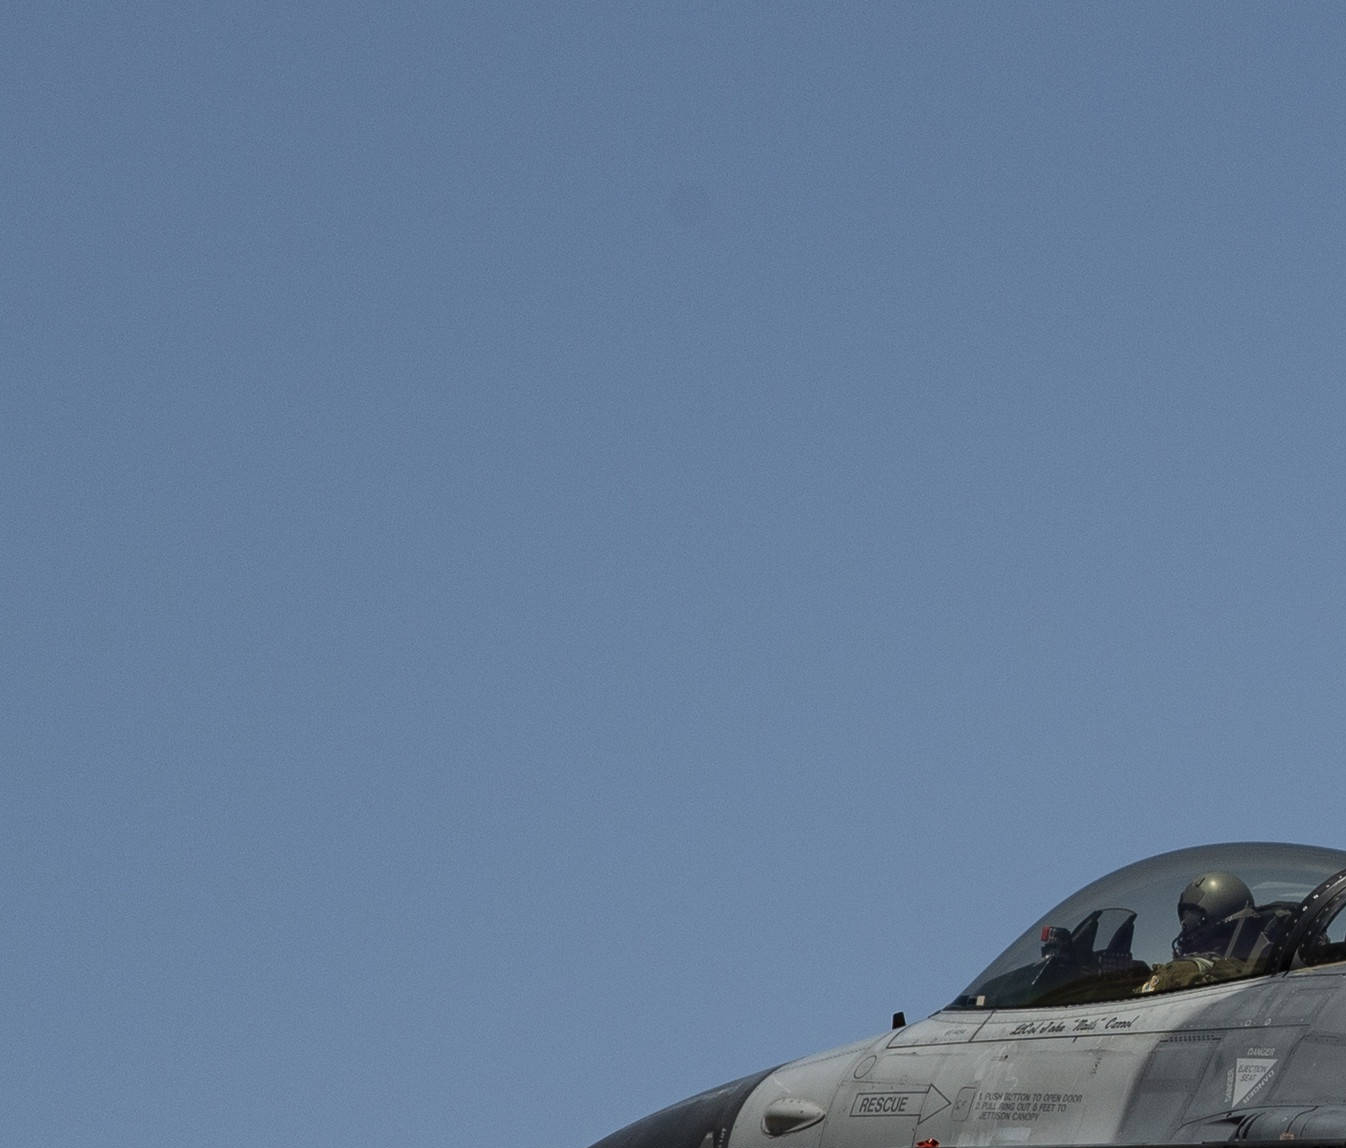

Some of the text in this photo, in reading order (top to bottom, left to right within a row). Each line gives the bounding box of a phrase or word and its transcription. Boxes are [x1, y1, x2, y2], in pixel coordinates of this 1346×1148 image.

[1247, 1047, 1275, 1057] DANGER
[985, 1093, 1003, 1101] PUSH
[1004, 1093, 1031, 1102] BUTTON
[1033, 1093, 1042, 1102] TO
[1043, 1094, 1062, 1102] OPEN
[858, 1097, 909, 1113] RESCUE
[982, 1102, 997, 1110] PULL
[1016, 1103, 1031, 1112] OUT
[1039, 1103, 1056, 1112] FEET
[1057, 1104, 1067, 1112] TO
[1012, 1112, 1040, 1121] CANOPY
